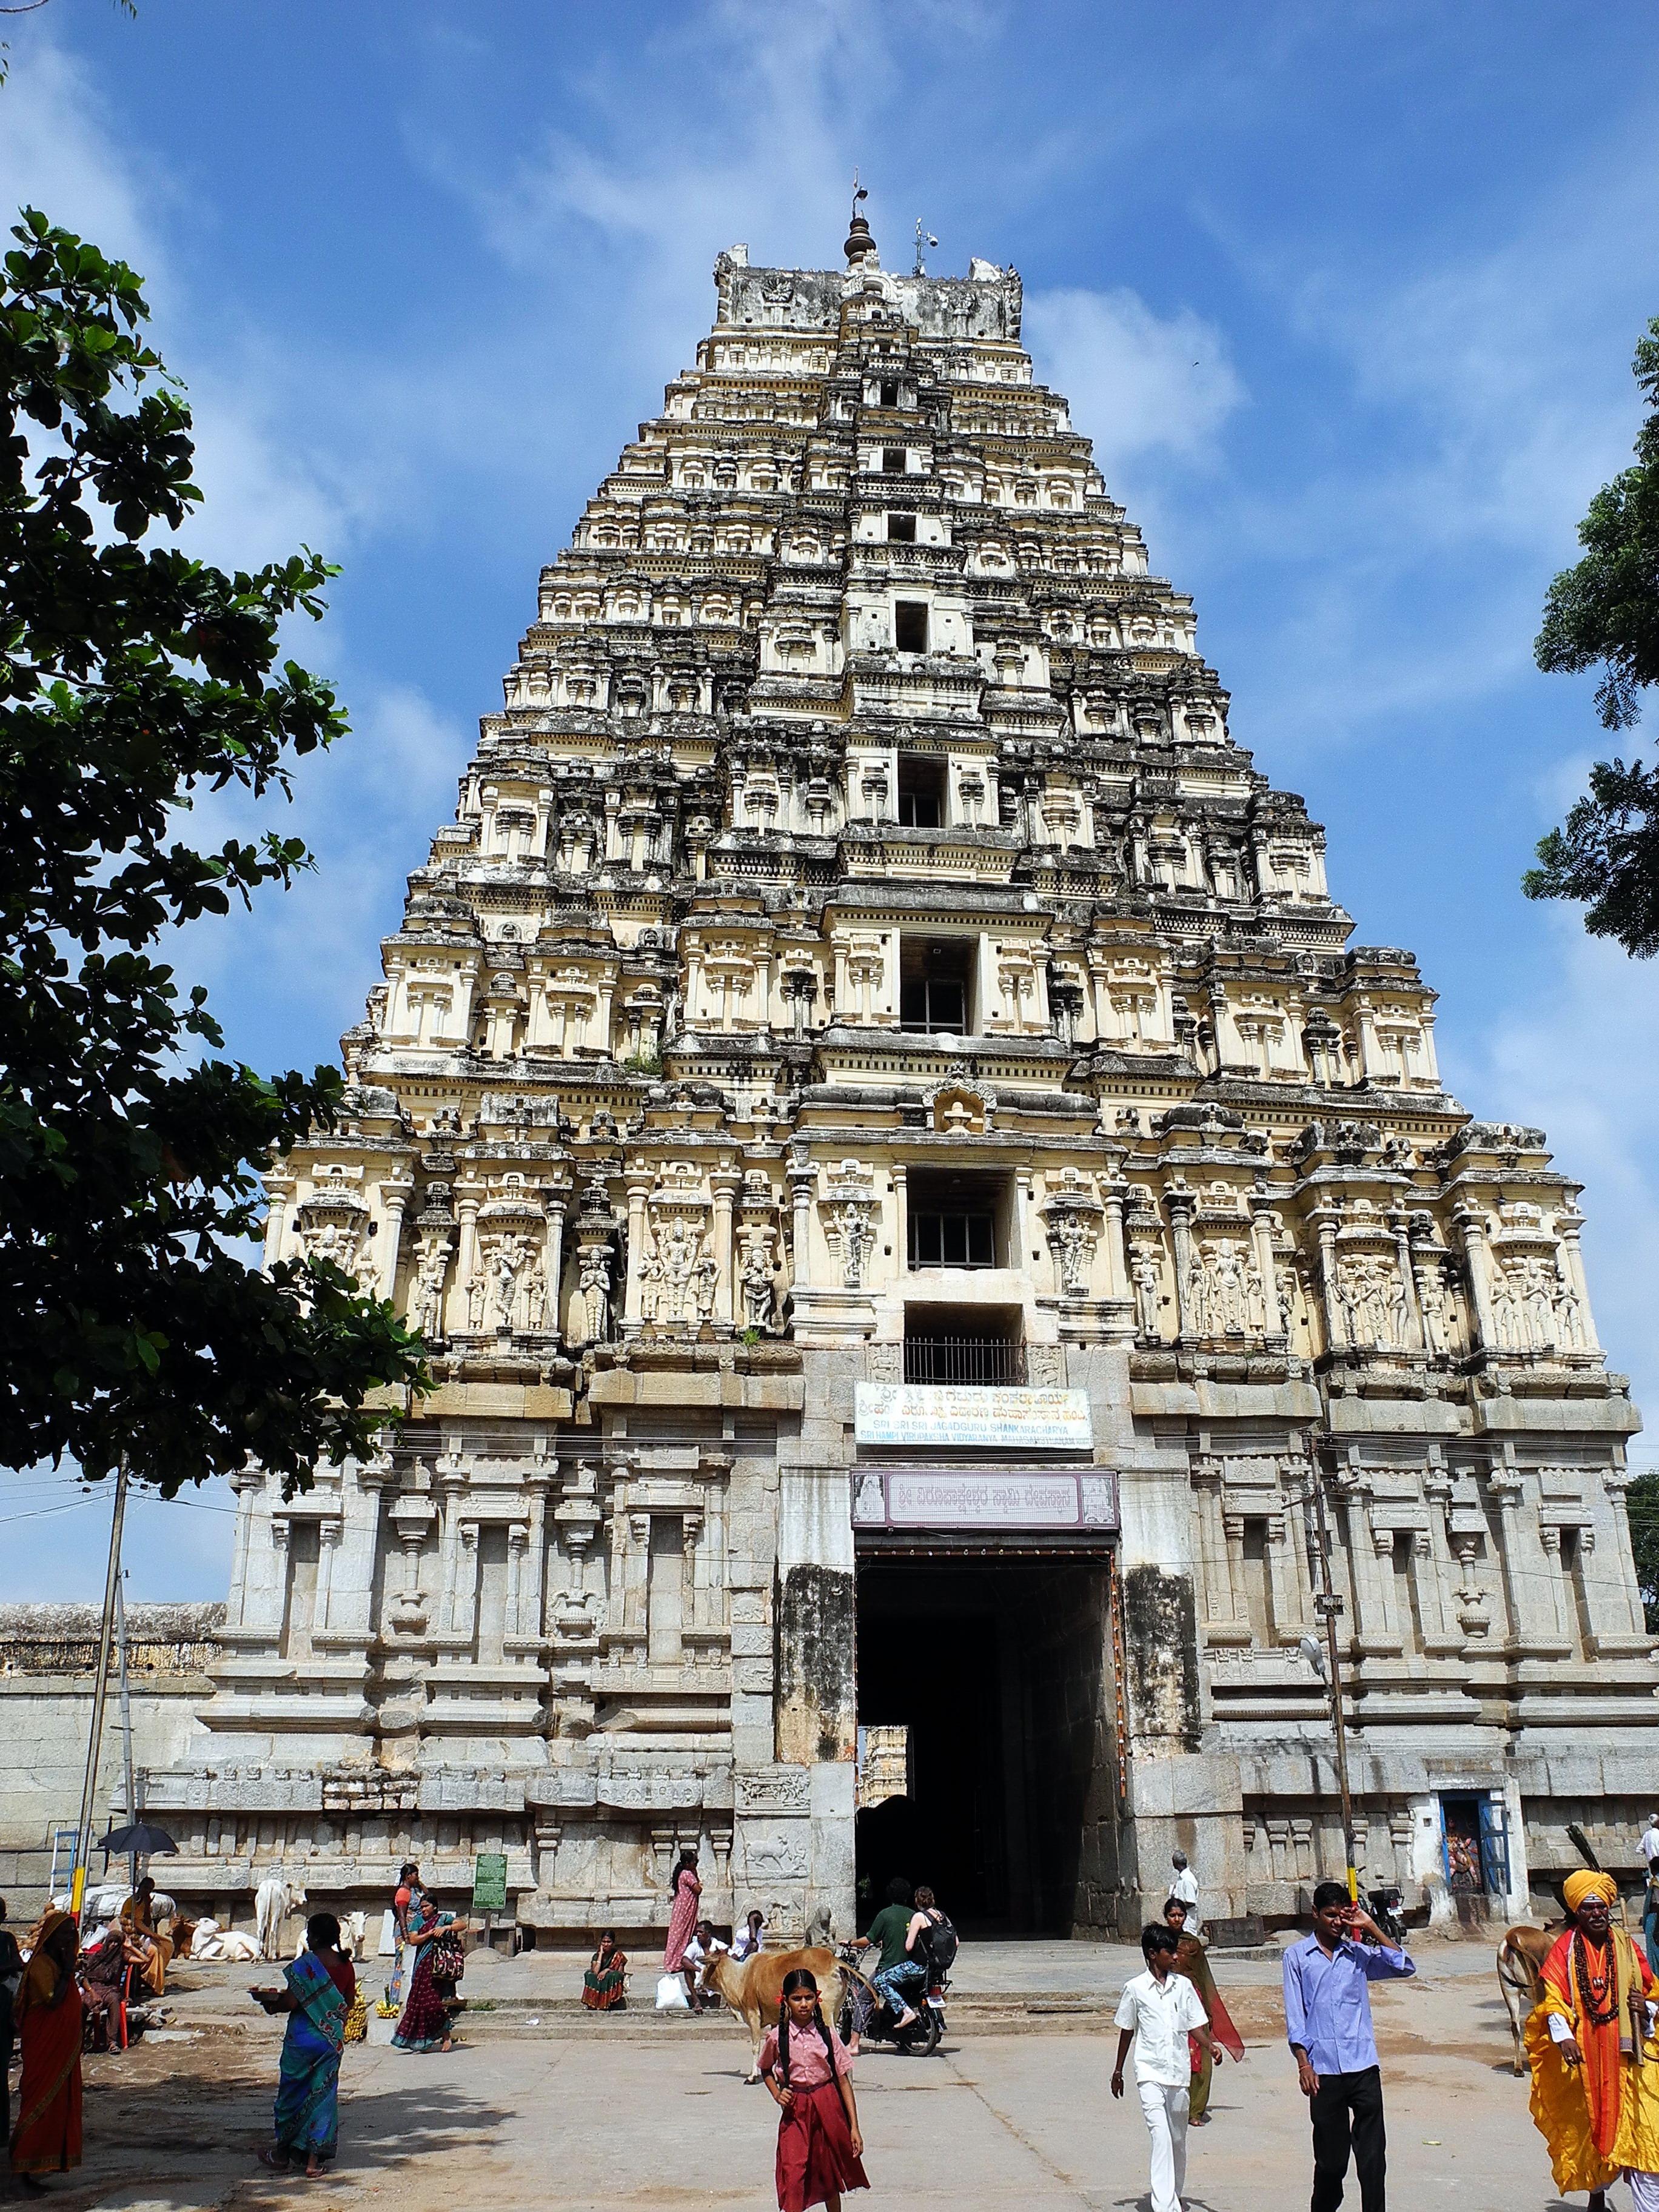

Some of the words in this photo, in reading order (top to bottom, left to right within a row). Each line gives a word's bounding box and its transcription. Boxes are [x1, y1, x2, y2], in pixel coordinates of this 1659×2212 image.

[873, 1419, 890, 1429] SRI
[893, 1420, 910, 1430] SRI
[911, 1421, 927, 1430] SRI
[930, 1421, 987, 1432] JAGADGURU
[990, 1423, 1068, 1435] SHANKARACHARYA
[860, 1430, 874, 1439] SRI
[876, 1431, 899, 1440] HAMPI
[901, 1432, 950, 1442] VIRUPAKSHA
[952, 1433, 997, 1443] VIDYARANYA
